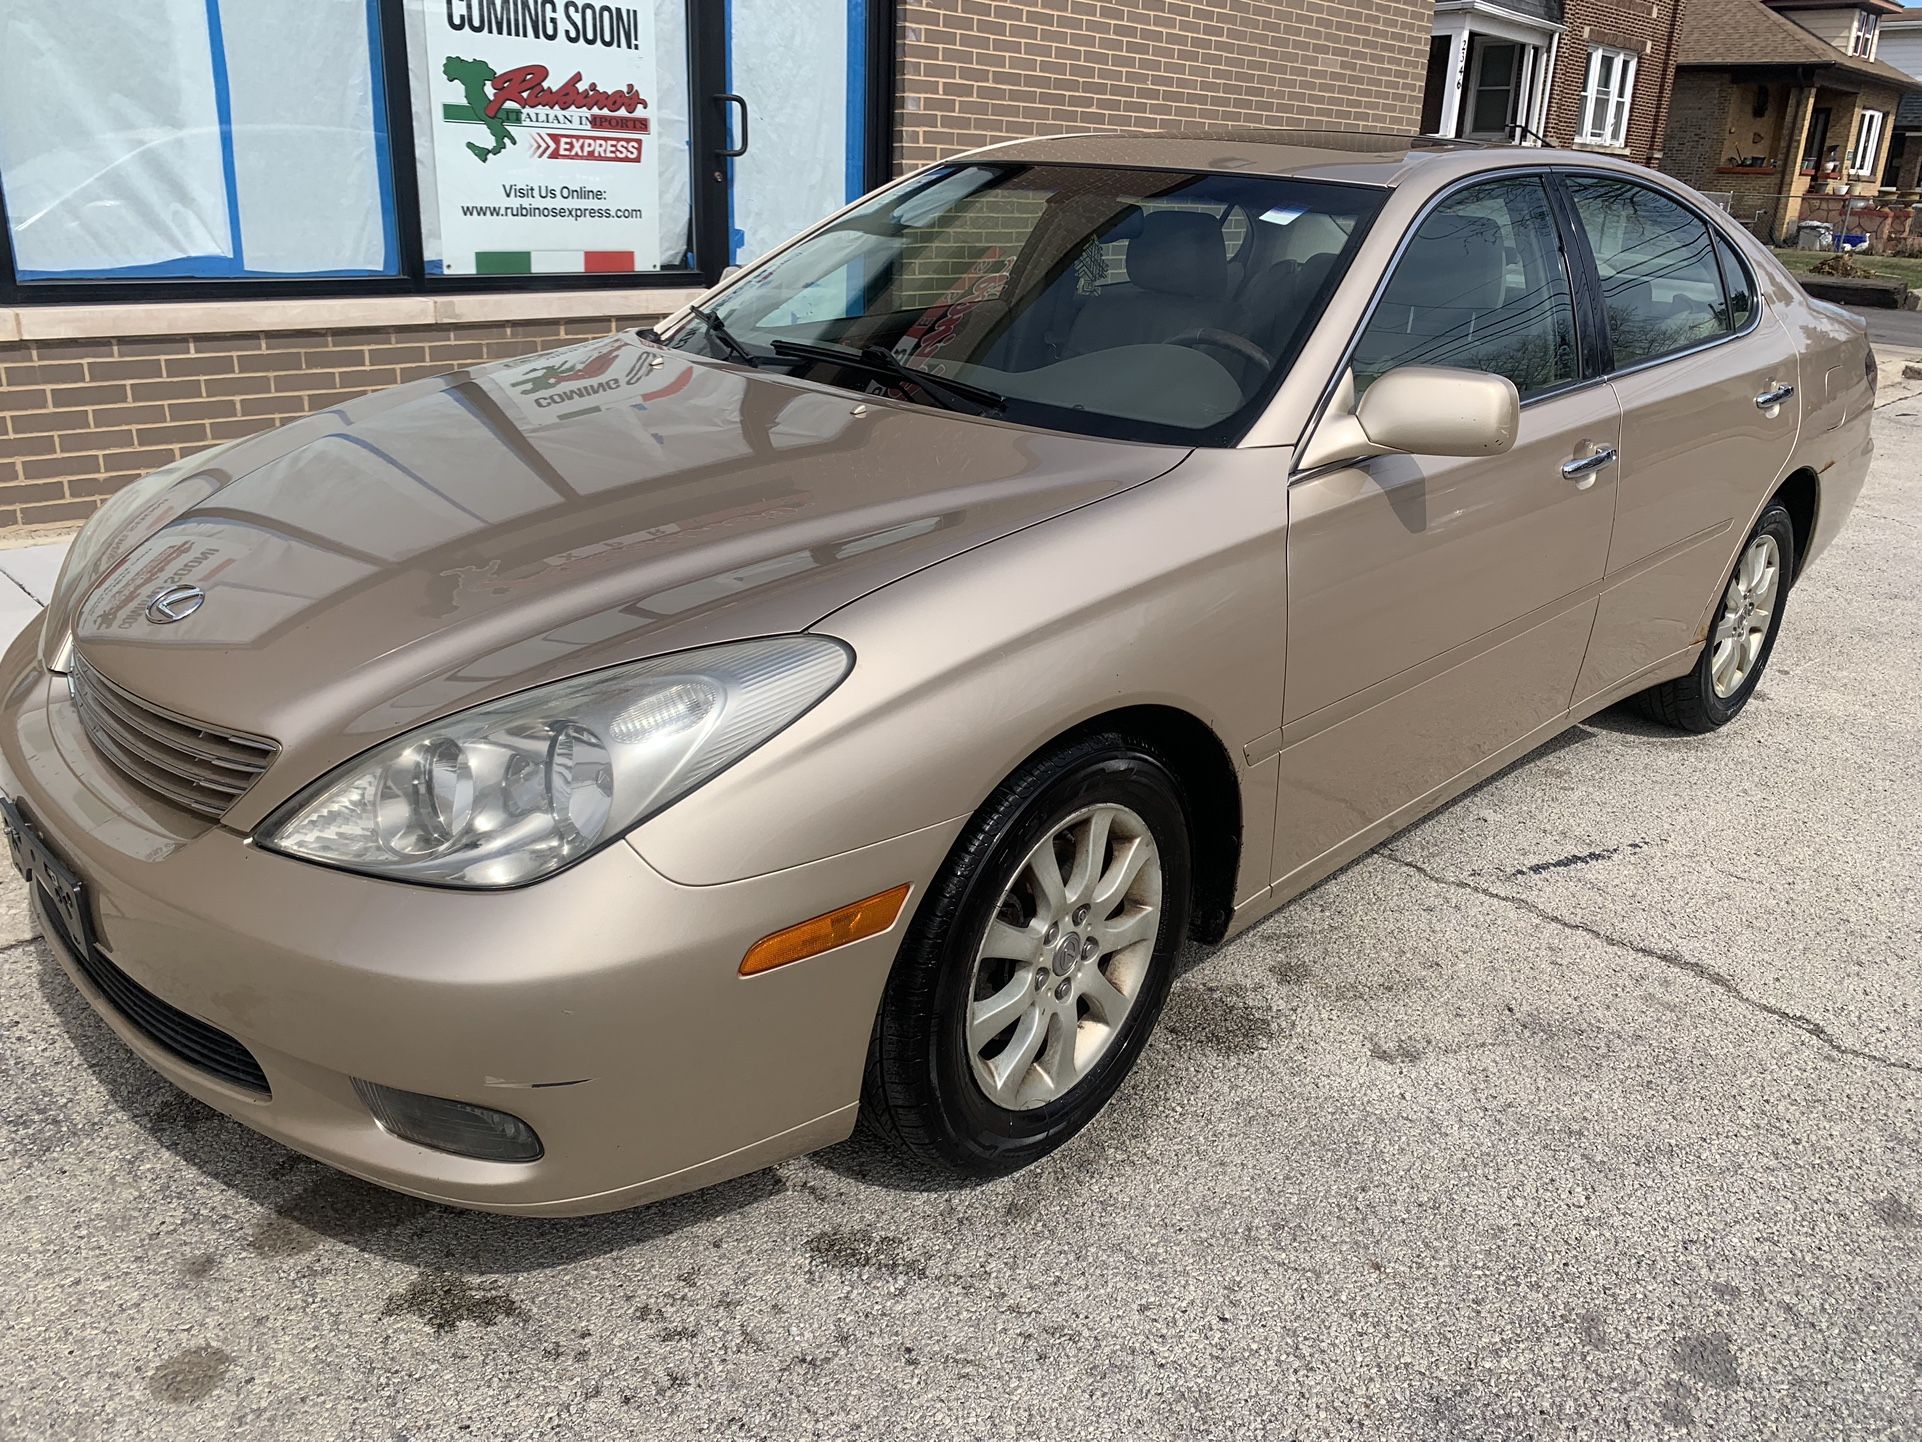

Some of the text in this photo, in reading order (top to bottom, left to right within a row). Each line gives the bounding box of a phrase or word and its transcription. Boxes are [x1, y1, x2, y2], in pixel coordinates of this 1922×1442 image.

[446, 0, 639, 50] COMING SOON!
[486, 65, 648, 118] Rubino's
[505, 110, 648, 130] ITALIAN IMPORTS
[559, 137, 638, 159] EXPRESS
[502, 184, 607, 200] Visit Us Online:
[461, 204, 642, 221] www.rubinosexpress.com
